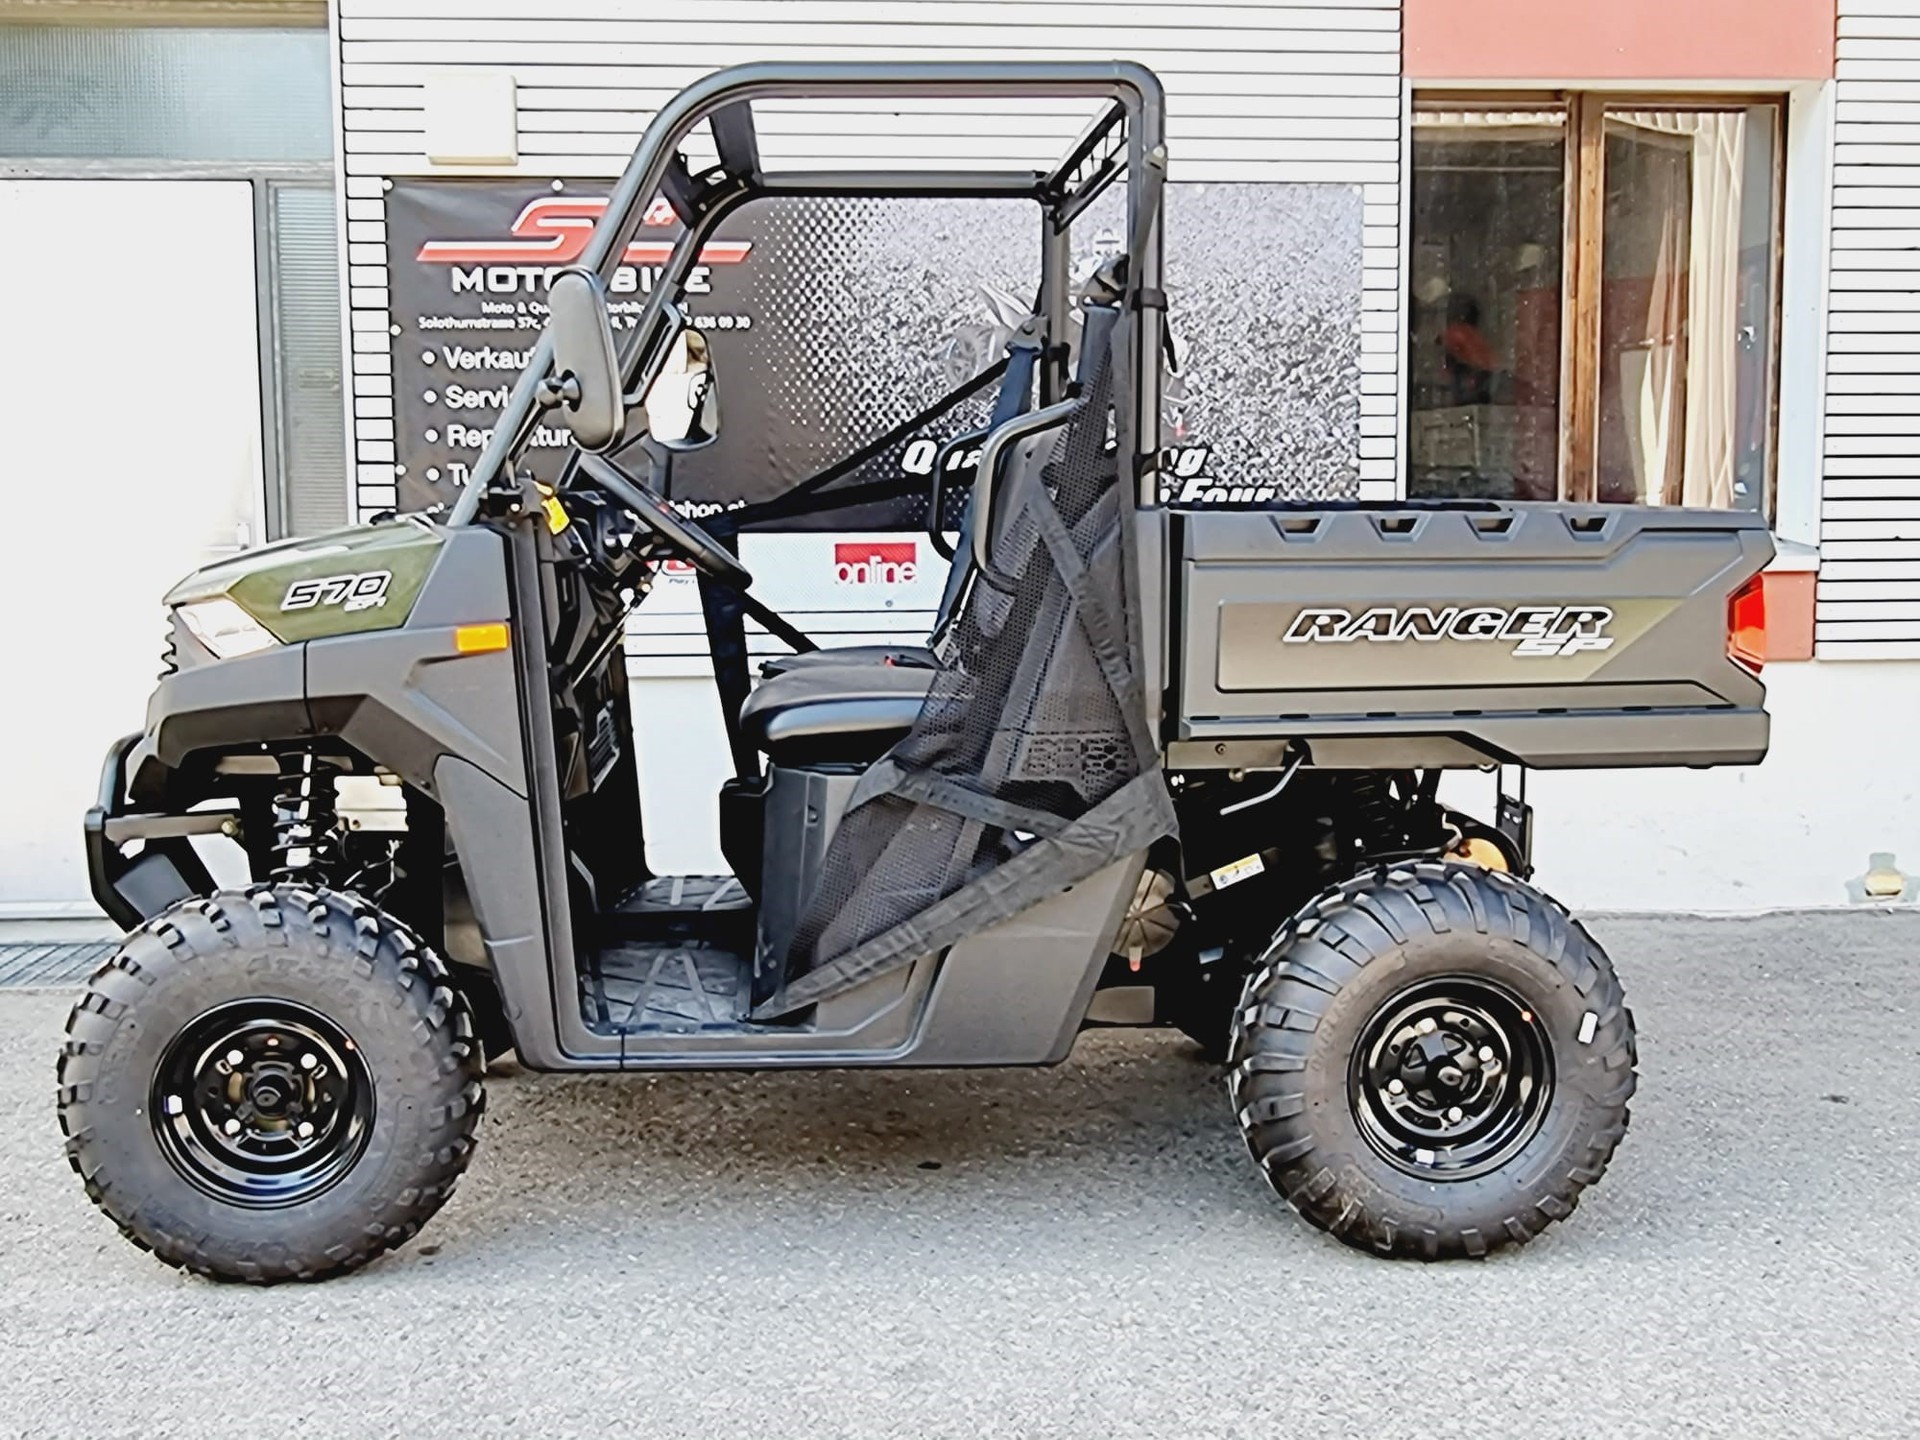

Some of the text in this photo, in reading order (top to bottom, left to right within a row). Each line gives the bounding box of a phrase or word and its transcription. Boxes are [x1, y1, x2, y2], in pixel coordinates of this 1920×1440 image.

[452, 266, 711, 293] MOTBIE
[481, 302, 515, 315] Moto
[445, 385, 513, 409] Servi
[835, 555, 917, 584] online
[281, 570, 392, 612] 570
[1283, 607, 1613, 642] RANGER
[1512, 638, 1614, 656] SP
